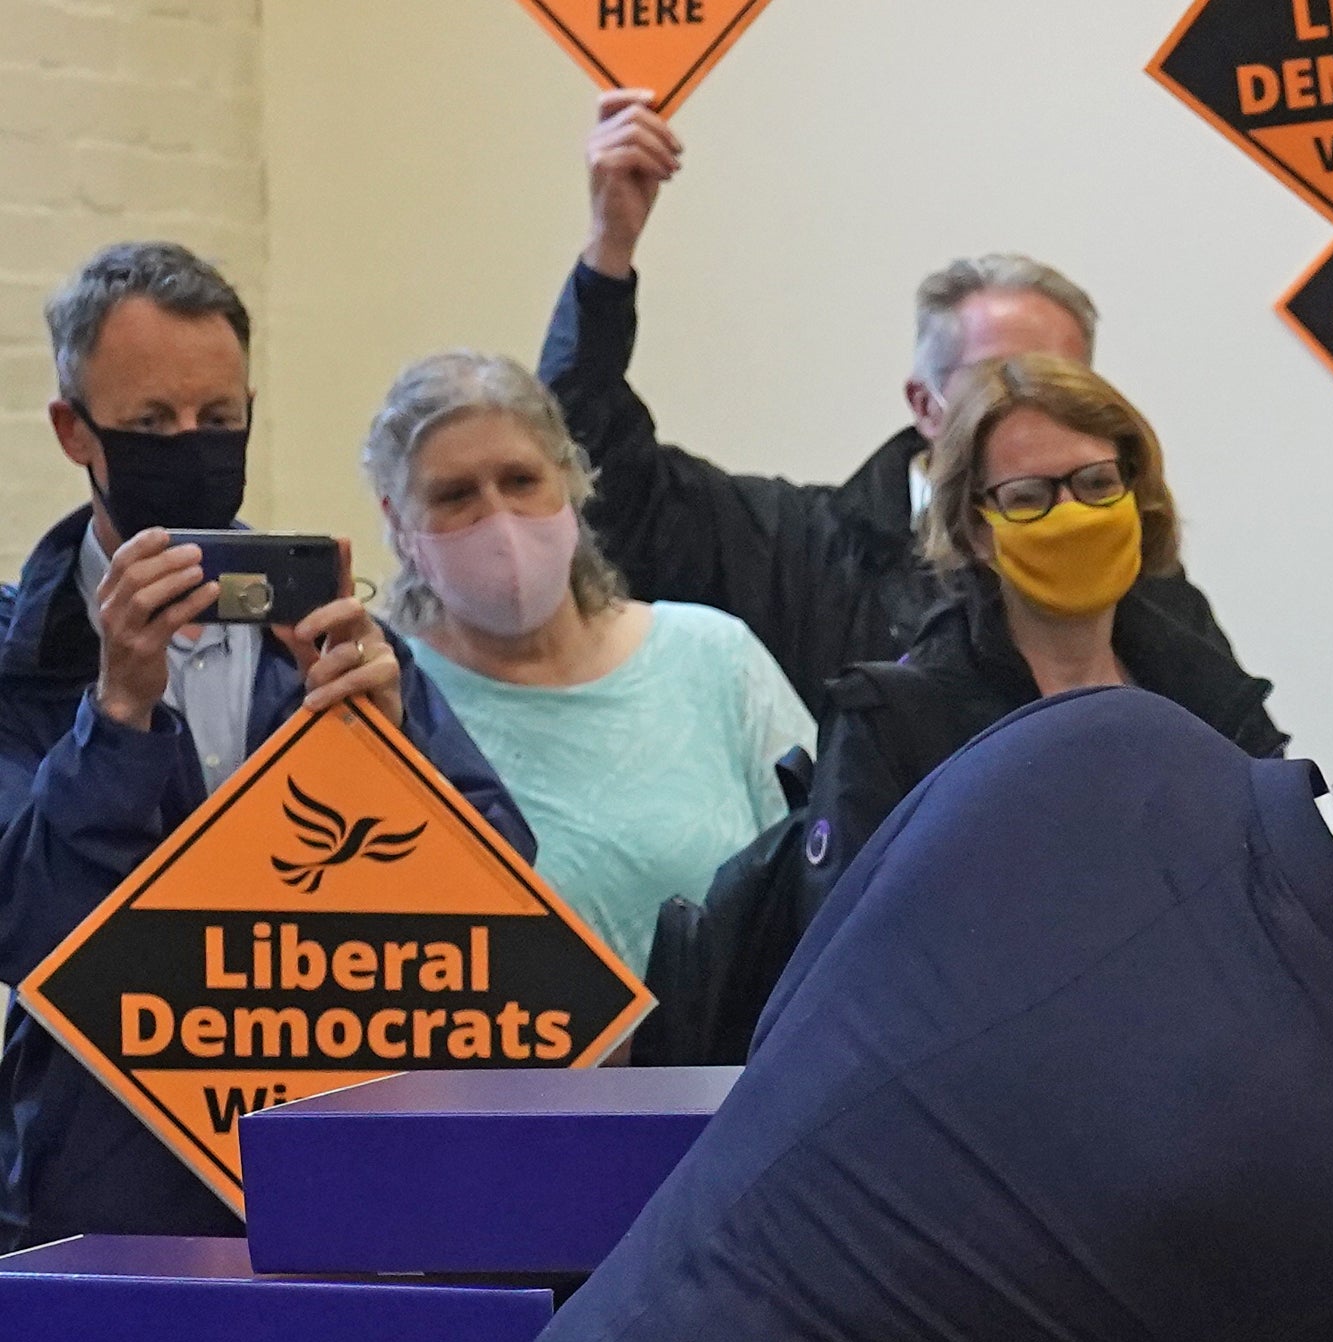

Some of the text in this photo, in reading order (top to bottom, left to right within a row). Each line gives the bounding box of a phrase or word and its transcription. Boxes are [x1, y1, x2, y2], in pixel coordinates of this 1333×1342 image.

[597, 0, 704, 30] HERE
[204, 922, 490, 992] Liberal
[120, 993, 573, 1059] Democrats
